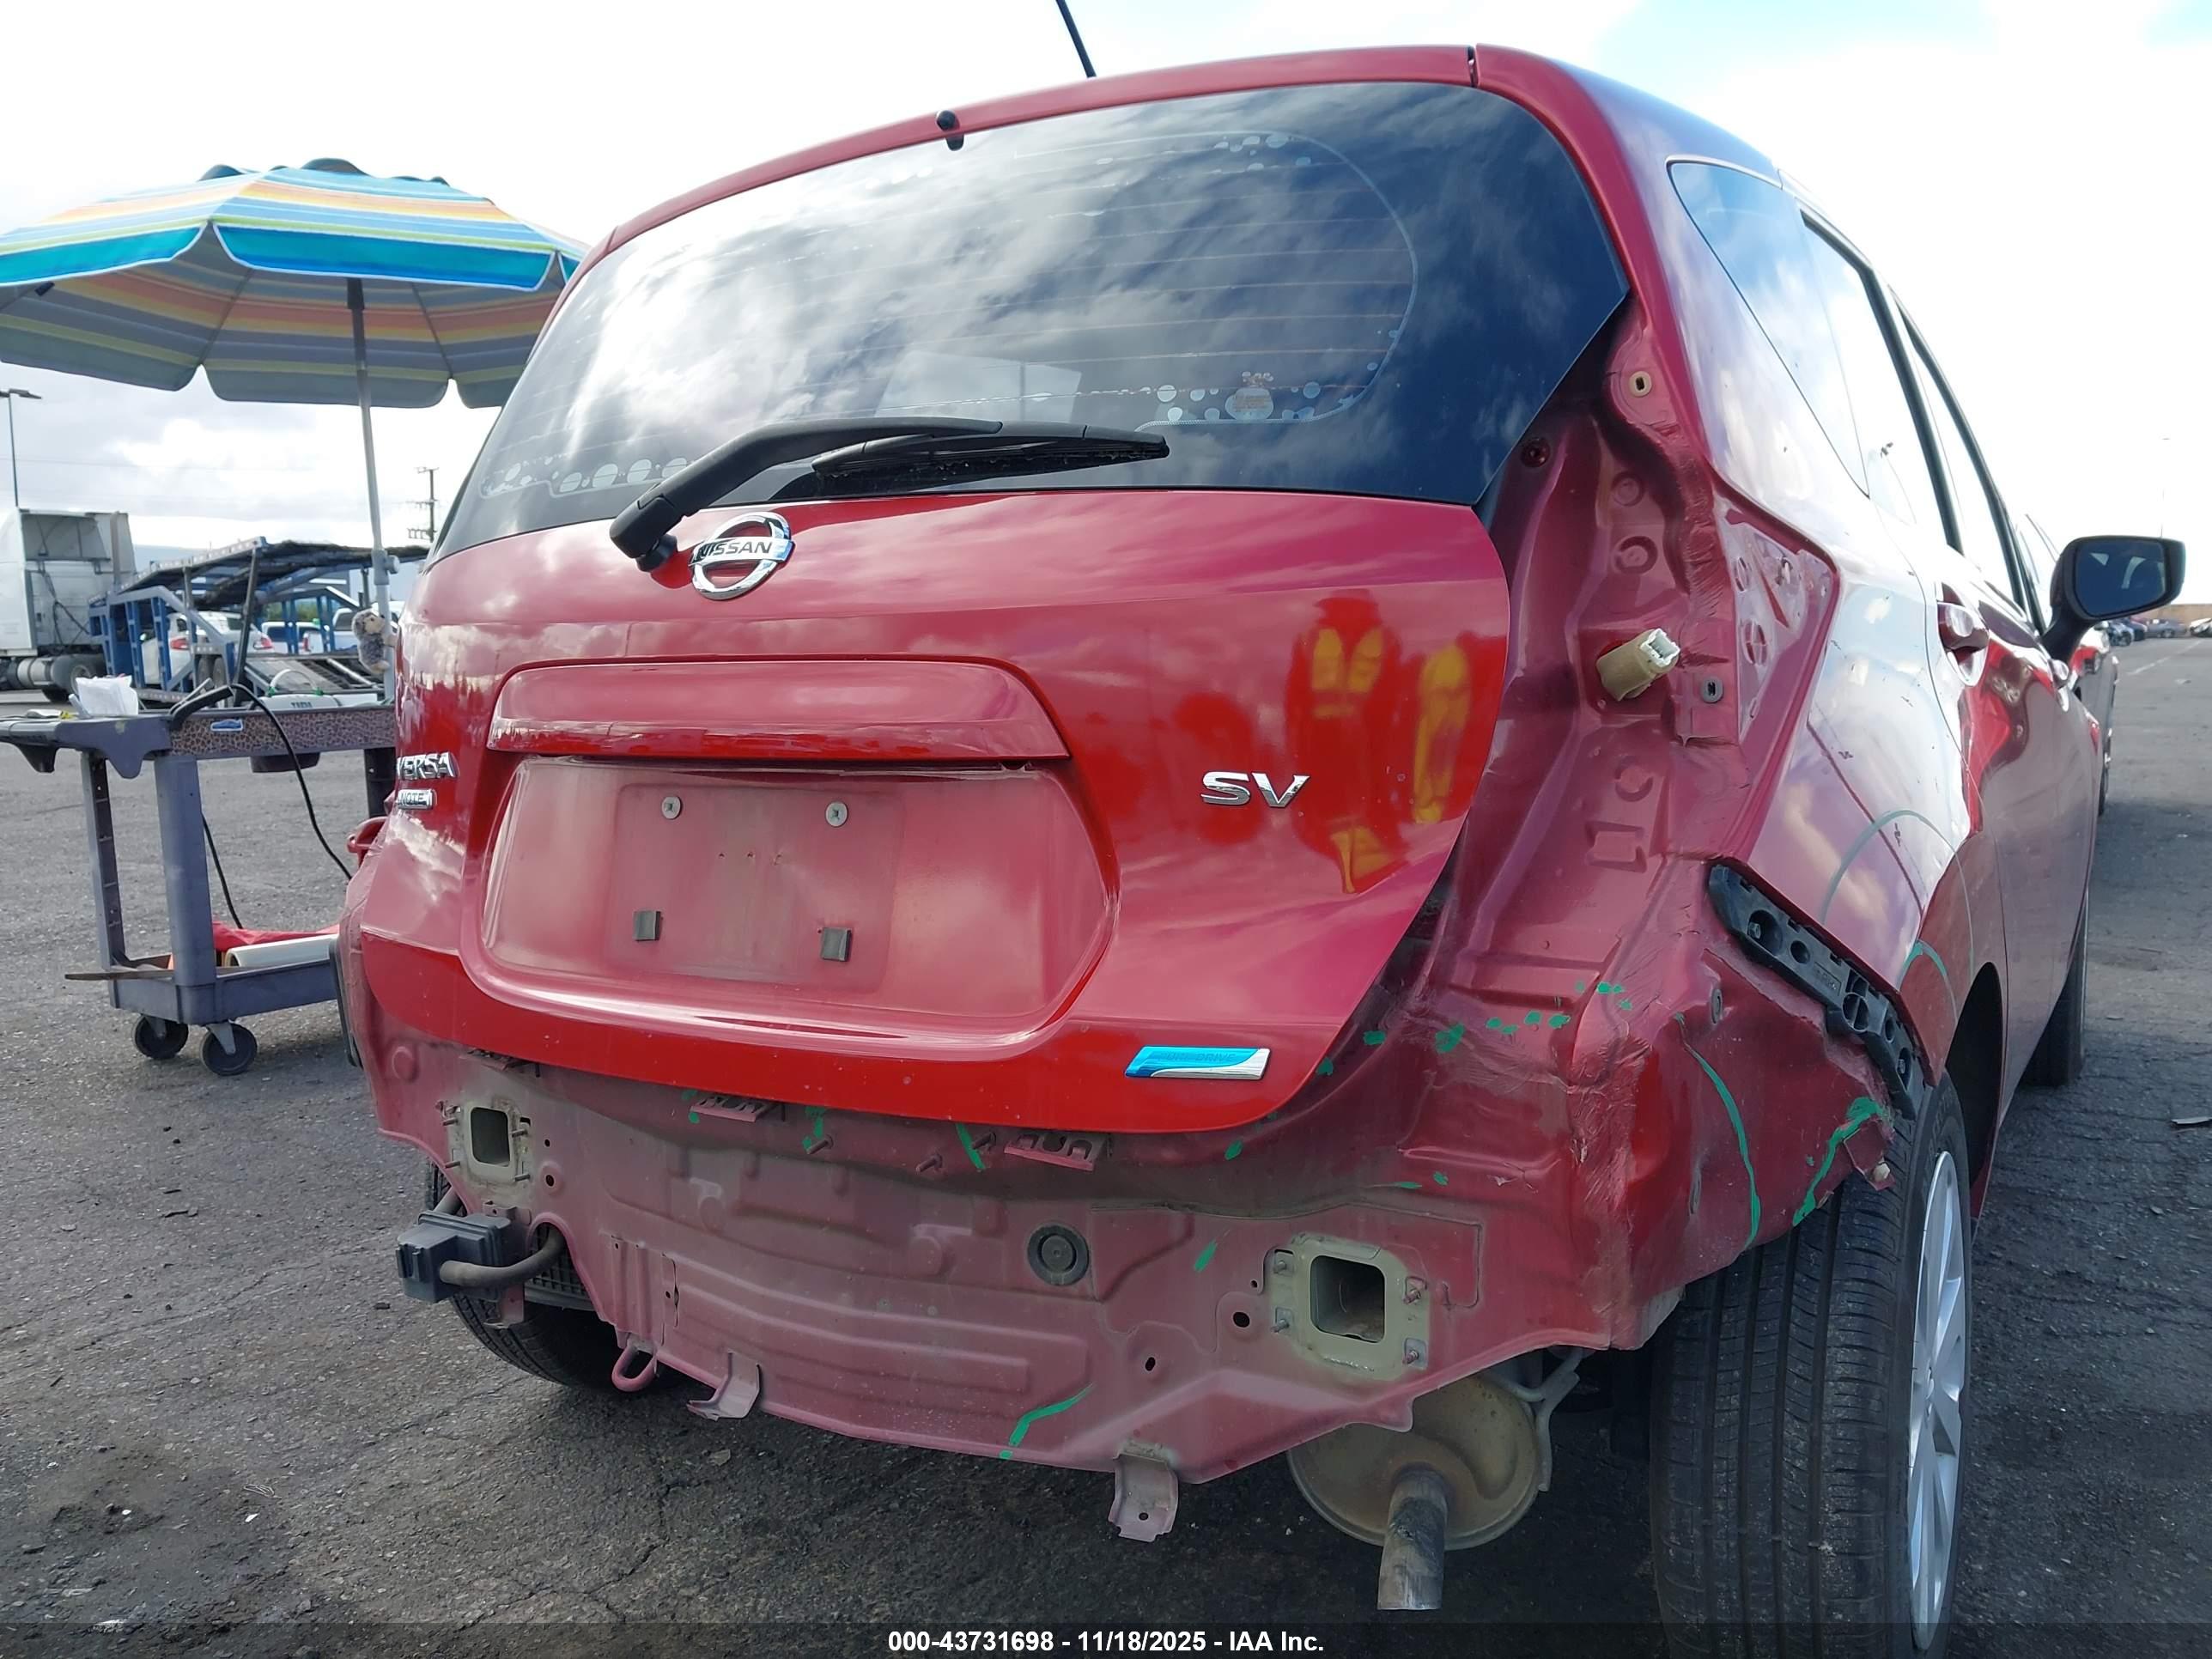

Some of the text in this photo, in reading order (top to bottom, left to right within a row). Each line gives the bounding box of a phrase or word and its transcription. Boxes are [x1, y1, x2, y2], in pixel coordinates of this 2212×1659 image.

[696, 541, 772, 561] NISSAN
[1201, 771, 1310, 807] SV
[1194, 1052, 1237, 1063] DRIVE
